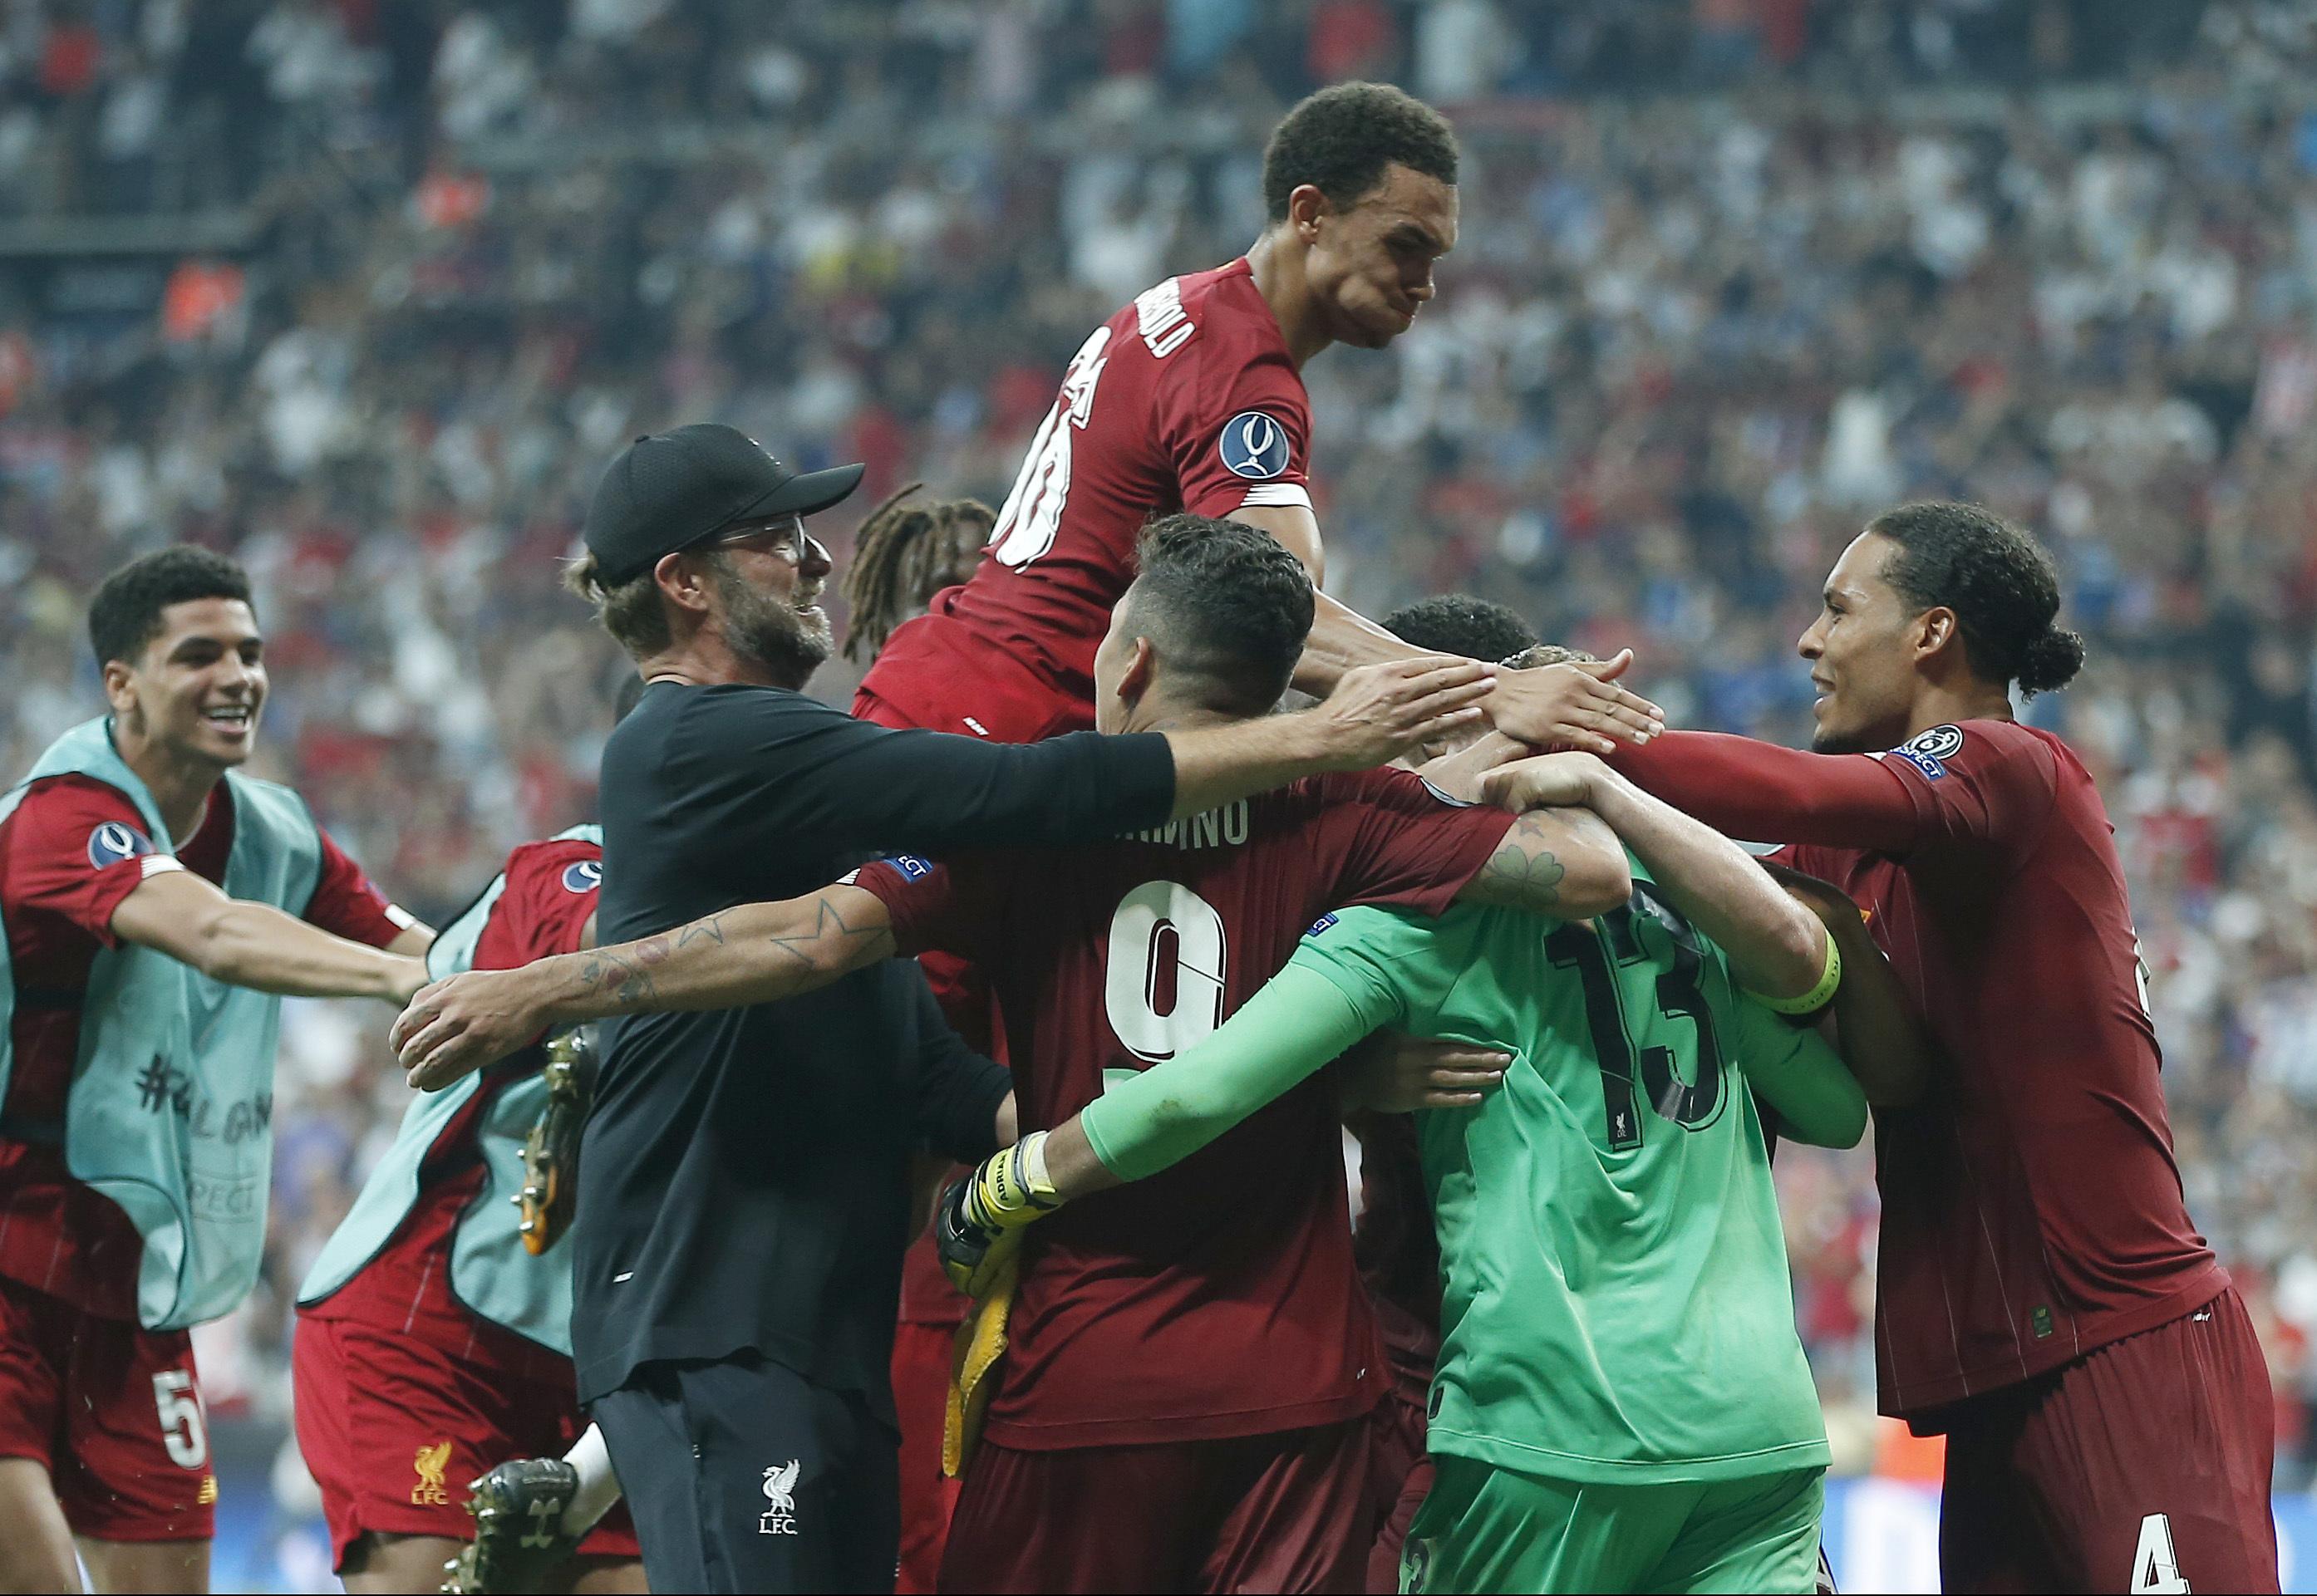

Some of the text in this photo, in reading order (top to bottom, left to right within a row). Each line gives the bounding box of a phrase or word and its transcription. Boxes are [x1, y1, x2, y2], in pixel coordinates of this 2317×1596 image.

[1103, 879, 1228, 1097] 9
[1543, 877, 1729, 1152] 13
[2129, 1512, 2192, 1594] 4
